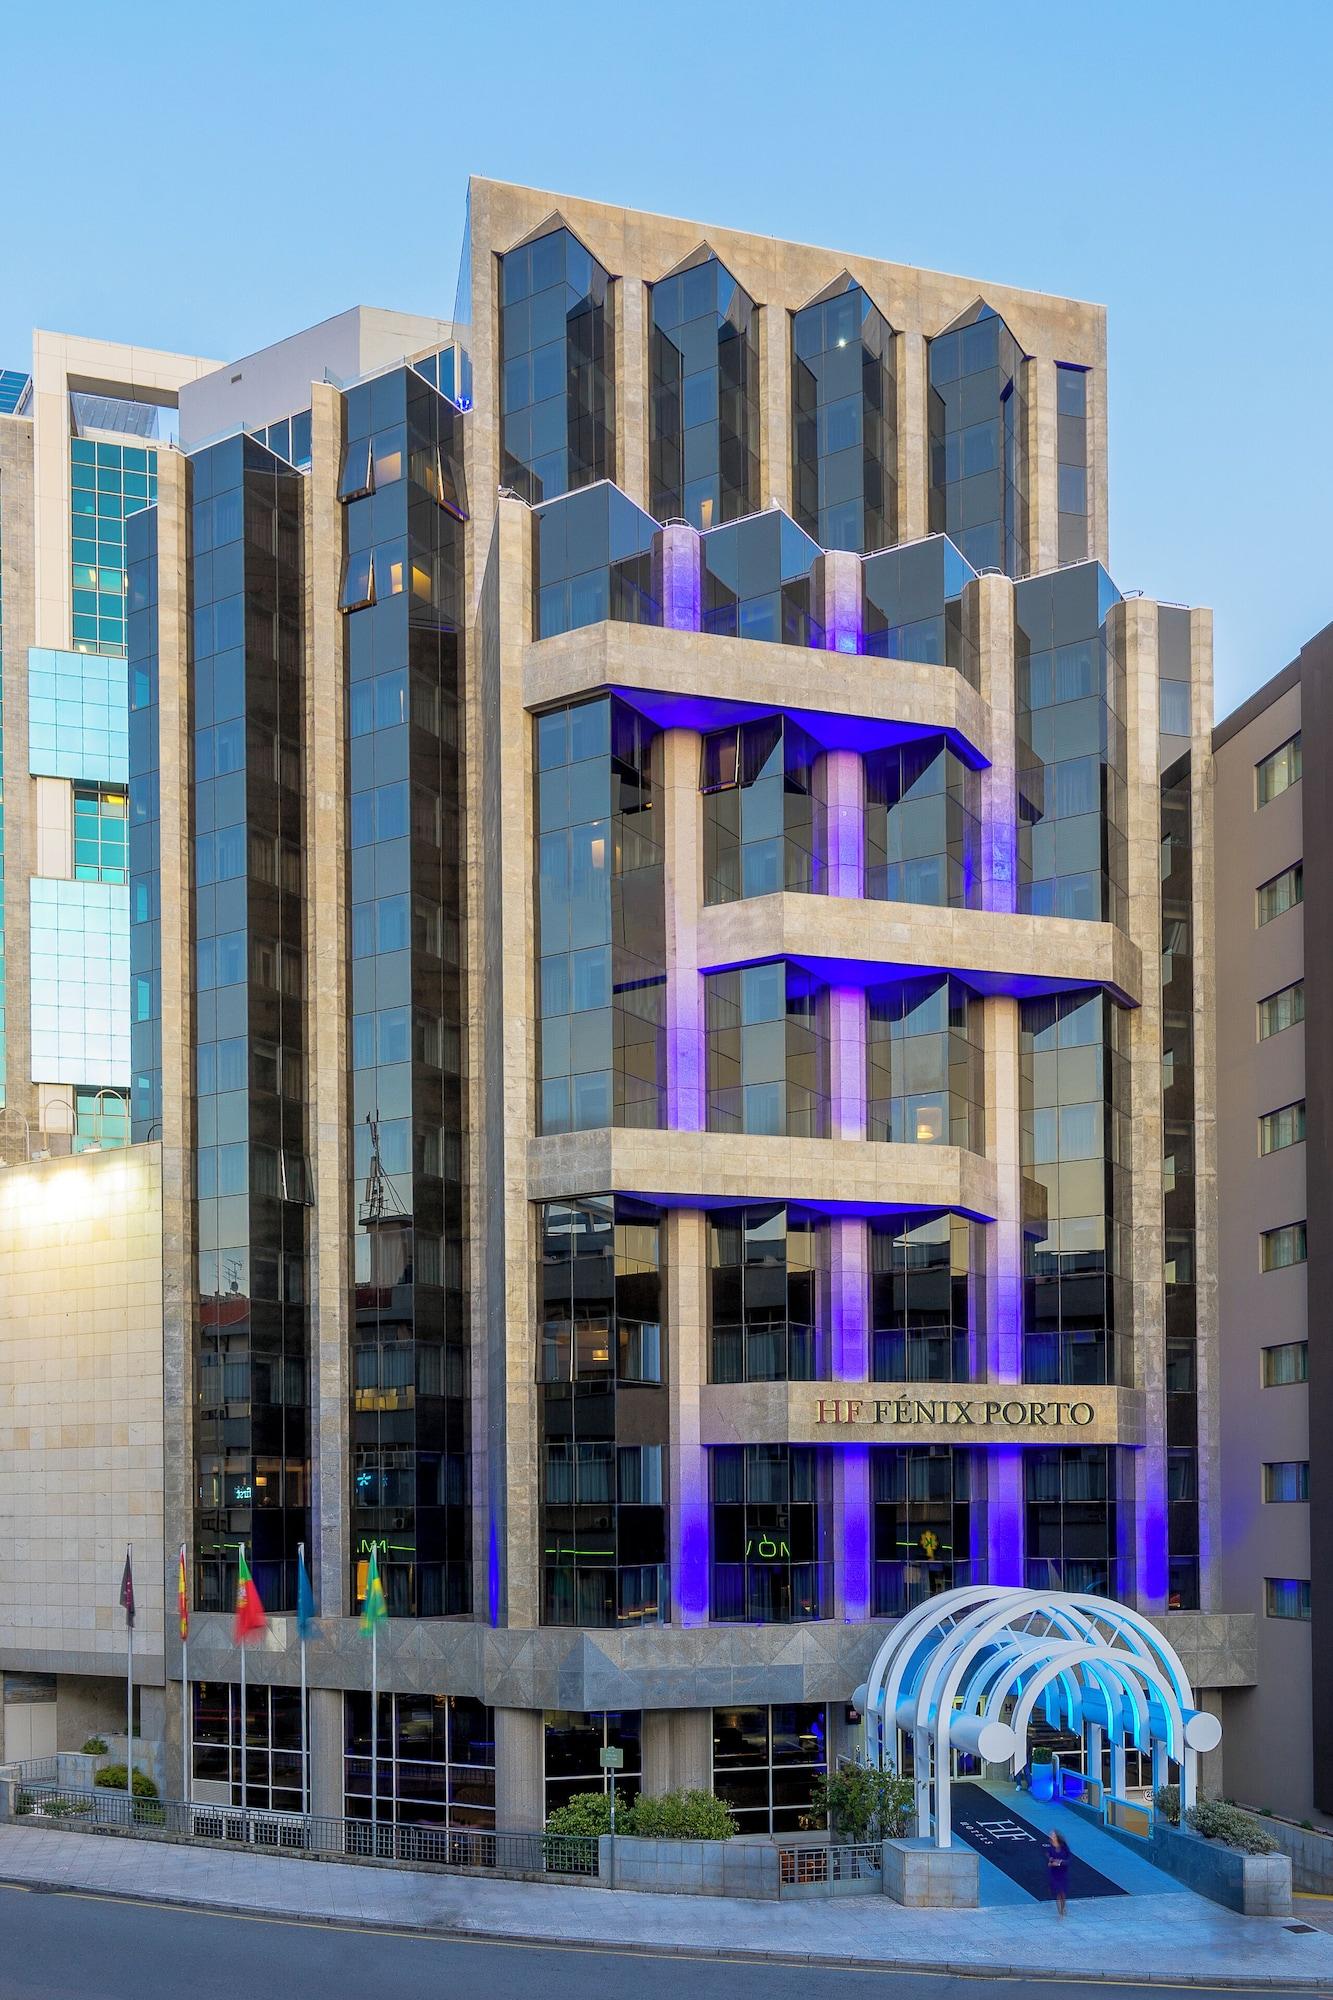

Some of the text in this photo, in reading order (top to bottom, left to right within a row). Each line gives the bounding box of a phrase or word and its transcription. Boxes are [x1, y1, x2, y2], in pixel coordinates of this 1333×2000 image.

[815, 1394, 1095, 1425] HF FÉNIX PORTO
[975, 1819, 1037, 1842] HF
